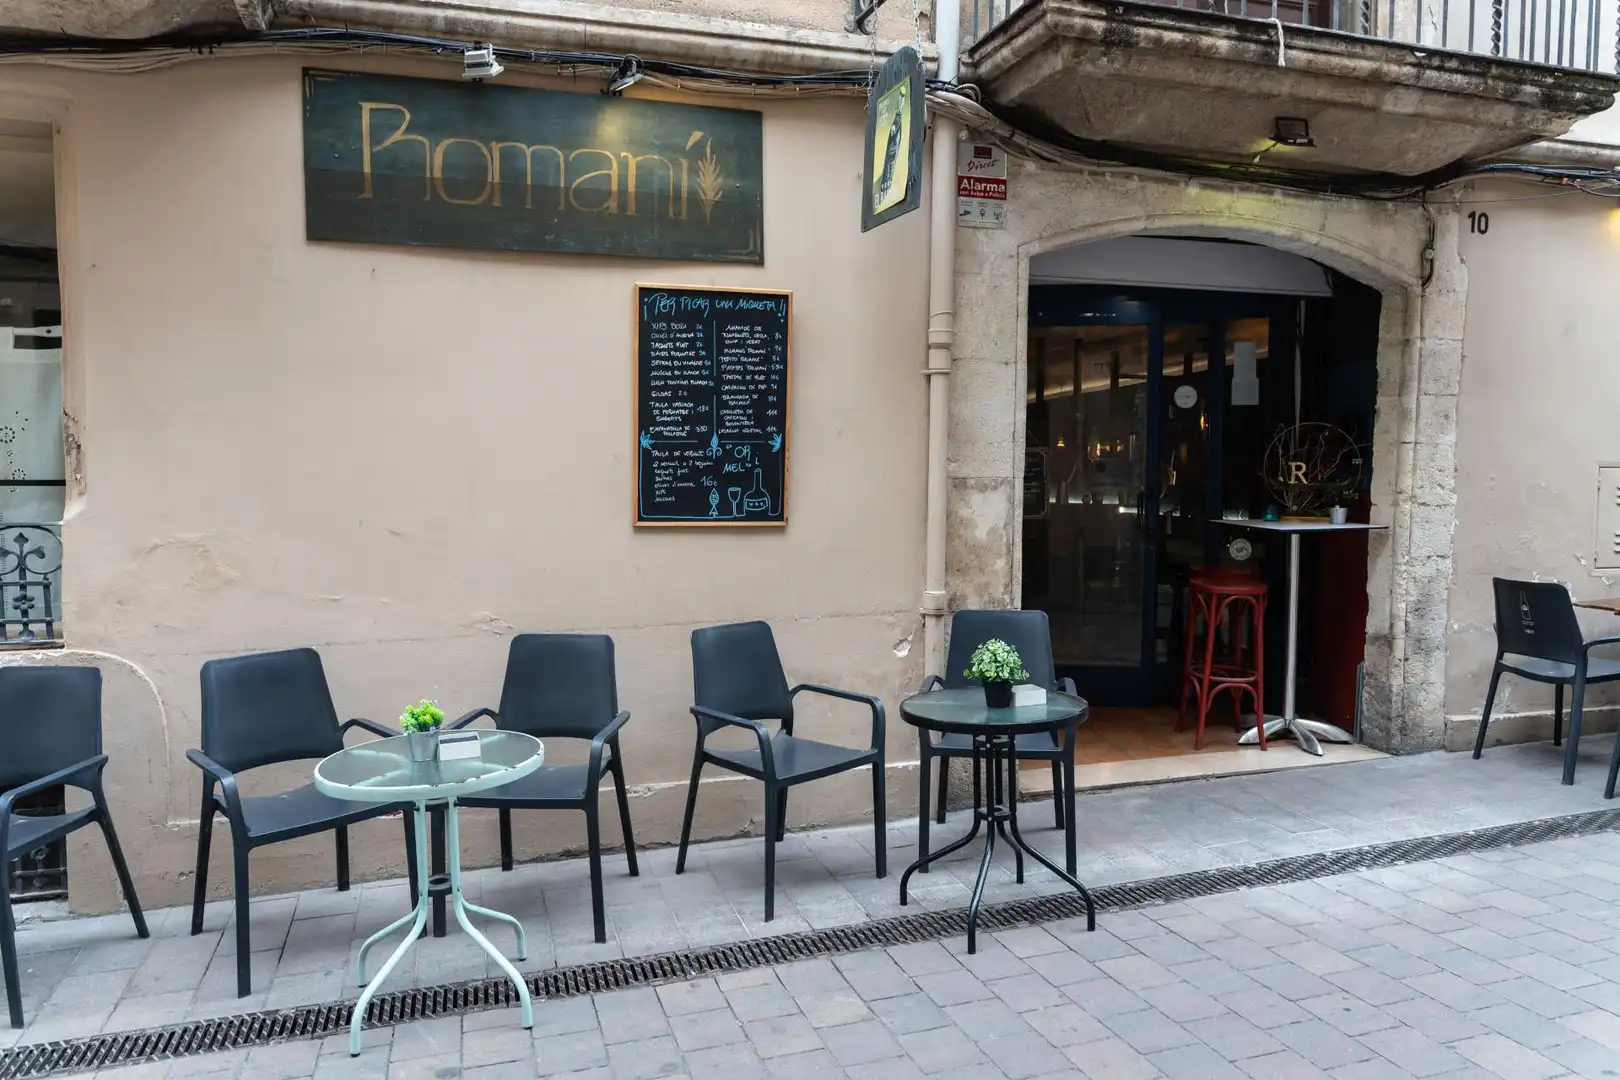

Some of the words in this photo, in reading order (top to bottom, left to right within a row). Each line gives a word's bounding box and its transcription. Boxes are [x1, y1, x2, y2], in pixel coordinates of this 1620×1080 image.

[358, 101, 705, 221] Romaní
[966, 159, 1000, 172] Direct
[960, 178, 1006, 192] Alarma
[1467, 210, 1490, 235] 10
[680, 296, 710, 318] PICAR
[1288, 461, 1308, 485] R
